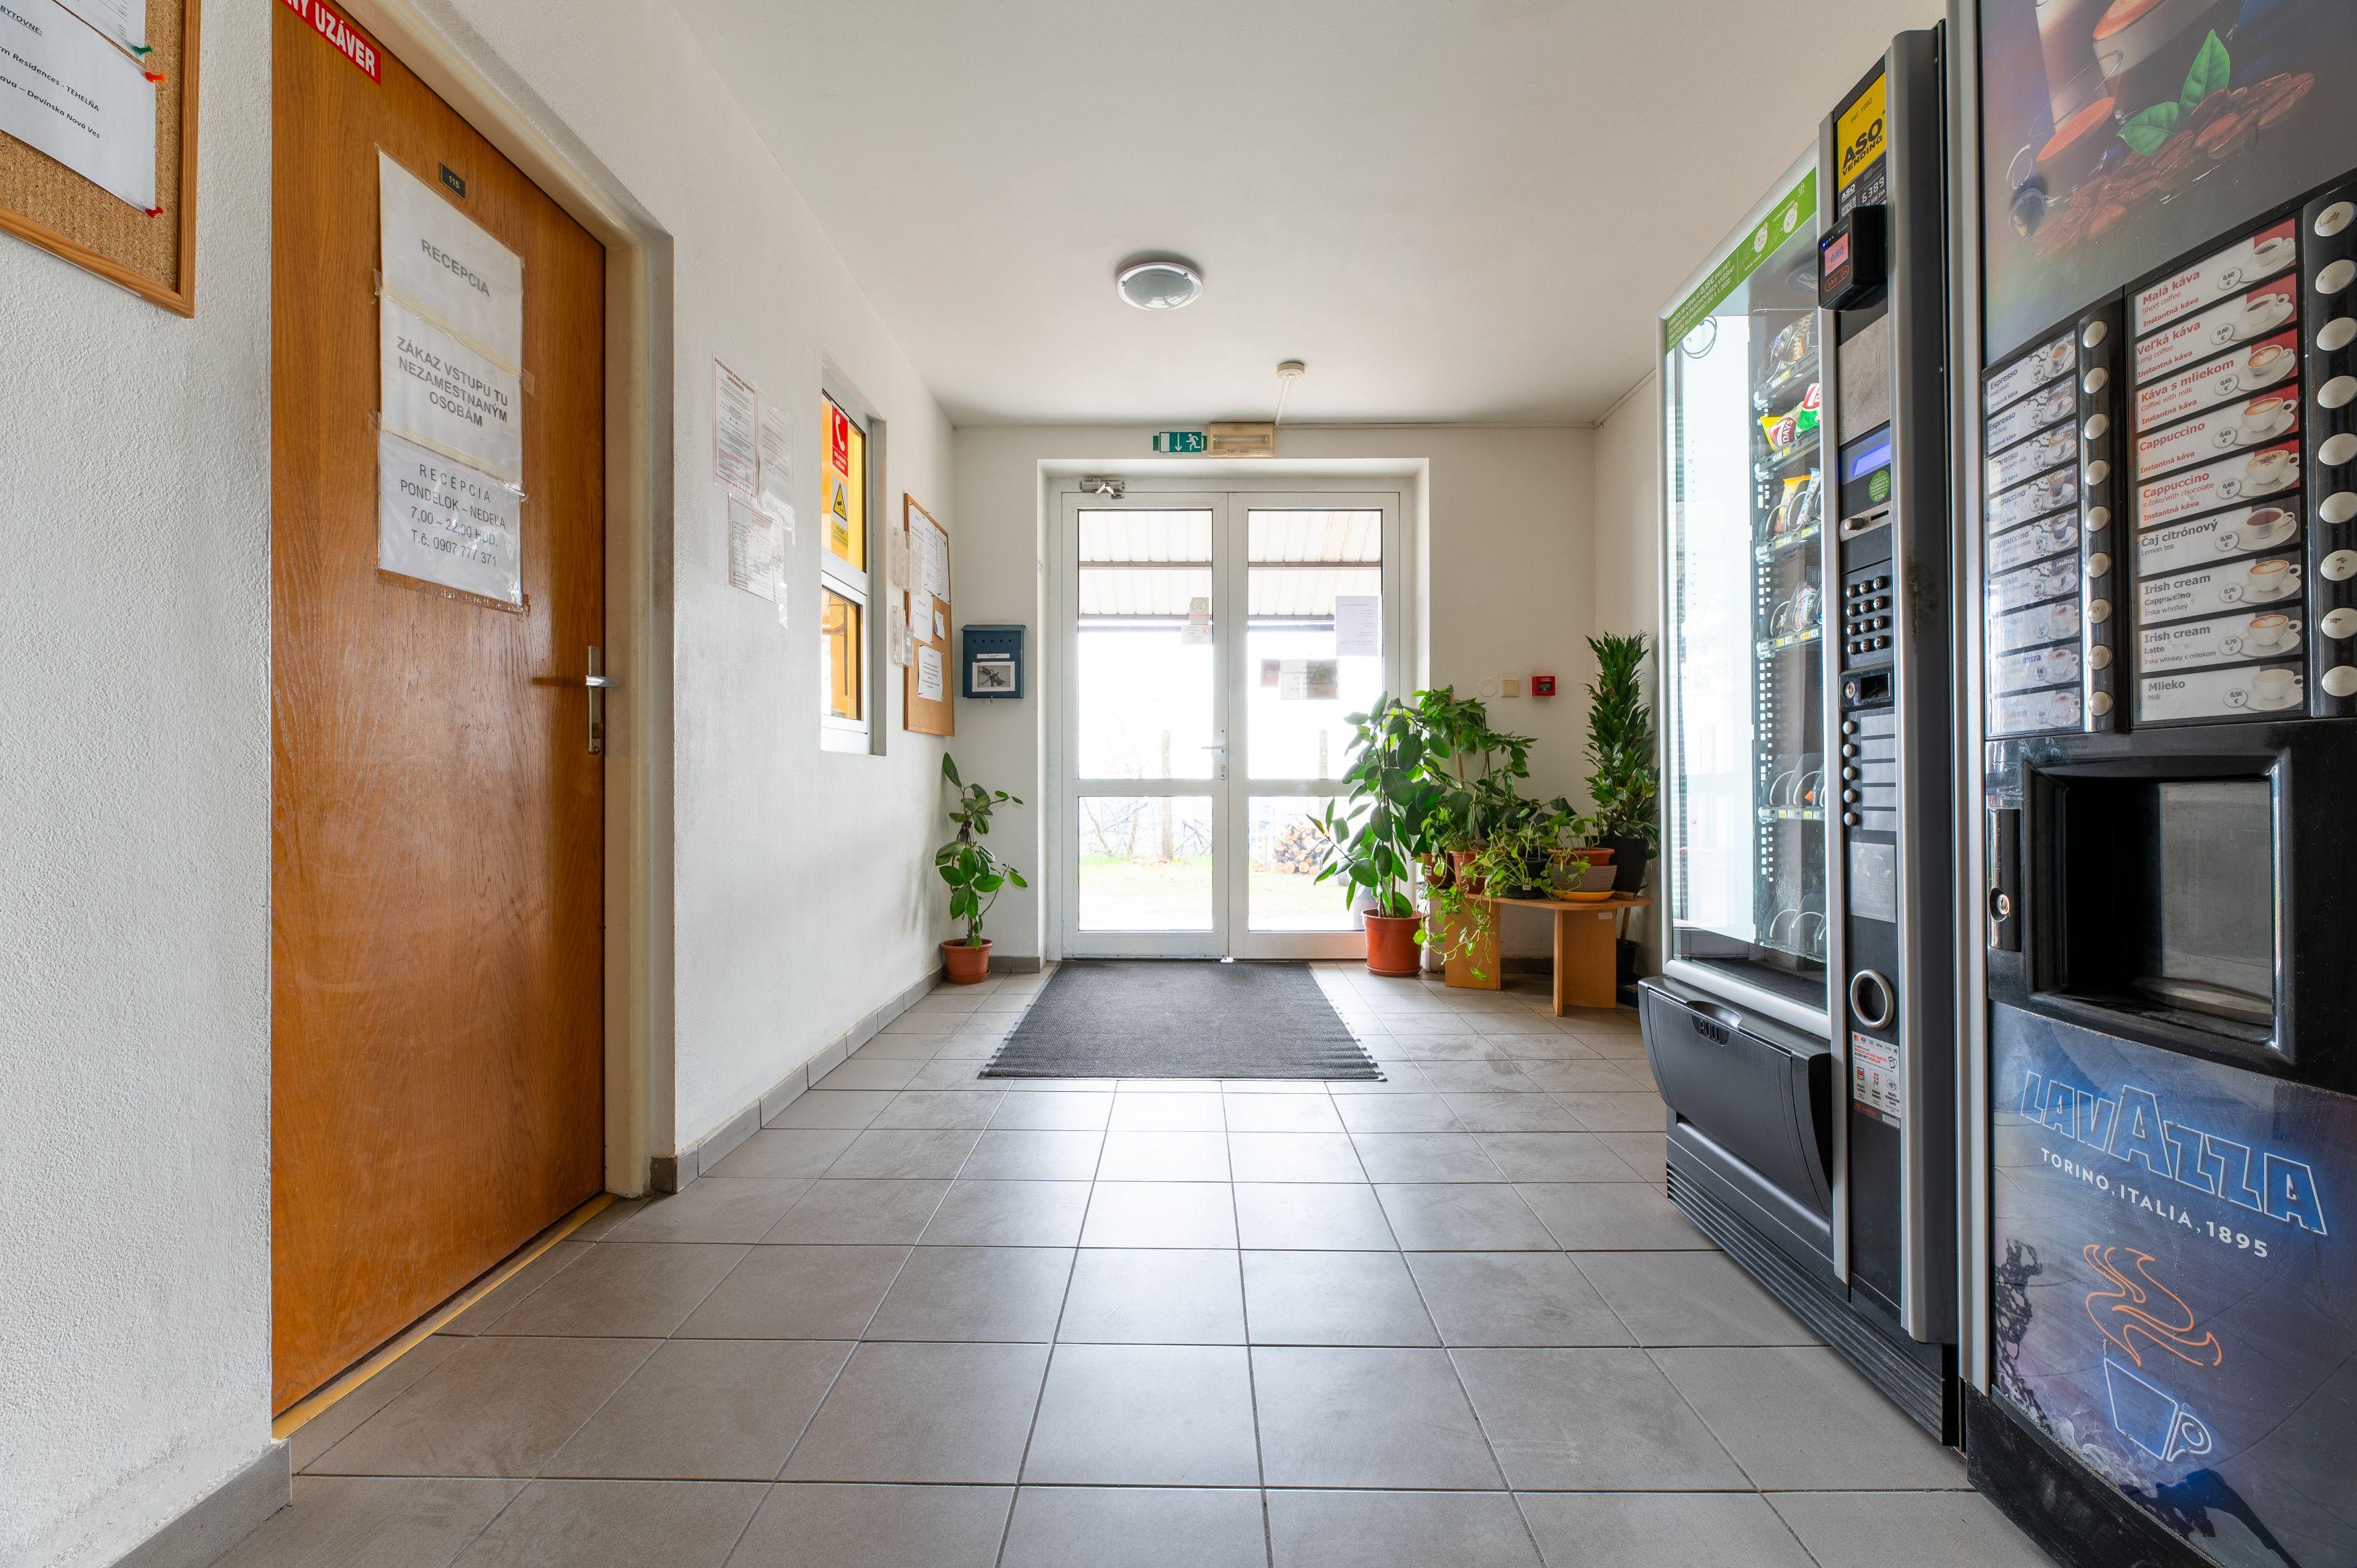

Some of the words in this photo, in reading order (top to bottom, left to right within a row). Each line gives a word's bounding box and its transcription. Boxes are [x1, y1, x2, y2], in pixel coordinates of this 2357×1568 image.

[0, 4, 43, 36] BYTOVNE:
[315, 2, 375, 77] UZÁVER
[12, 53, 60, 86] Residences
[66, 85, 99, 112] TEHELŇA
[27, 89, 65, 116] Devínska
[66, 113, 86, 130] Nová
[87, 126, 101, 139] Ves
[1860, 97, 1873, 113] 1992
[1842, 118, 1883, 170] ASO
[1842, 135, 1883, 176] VENDING
[448, 175, 460, 189] 115
[1841, 183, 1857, 200] ASO
[421, 239, 491, 298] RECEPCIA
[2223, 271, 2235, 281] 0,60
[2143, 285, 2169, 305] Malá
[2172, 271, 2201, 291] káva
[2142, 302, 2159, 314] Short
[2161, 291, 2181, 306] coffee
[2143, 306, 2178, 327] Instantná
[2181, 297, 2199, 310] káva
[2137, 335, 2170, 356] Veľká
[2173, 322, 2201, 340] káva
[2217, 327, 2228, 336] 0,60
[2137, 354, 2152, 365] Long
[2154, 345, 2173, 358] coffee
[2138, 359, 2173, 378] Instantná
[2174, 350, 2193, 362] káva
[397, 336, 441, 371] ZÁKAZ
[444, 362, 491, 398] VSTUPU
[494, 389, 508, 407] TU
[1990, 369, 2018, 390] Espresso
[2141, 385, 2168, 402] Káva
[2170, 382, 2178, 391] s
[2181, 359, 2234, 387] mliekom
[2220, 377, 2232, 386] 0,65
[399, 356, 508, 423] NEZAMESTNANÝM
[2008, 390, 2019, 399] káva
[2141, 399, 2162, 412] Coffee
[2162, 393, 2177, 404] with
[2178, 386, 2193, 397] milk
[429, 391, 483, 427] OSOBÁM
[1989, 412, 2016, 431] Espresso
[2141, 408, 2177, 425] Instantná
[2178, 400, 2197, 412] káva
[1783, 418, 1794, 444] DAYS
[2139, 422, 2206, 452] Cappuccino
[2140, 457, 2175, 474] Instantná
[2177, 451, 2196, 462] káva
[2143, 473, 2210, 499] Cappuccino
[401, 479, 460, 512] PONDELOK
[470, 505, 506, 529] NEDEĽA
[411, 506, 433, 525] 7,00
[2144, 505, 2179, 521] Instantná
[2181, 500, 2200, 510] káva
[2142, 534, 2159, 547] Čaj
[2162, 518, 2219, 542] citrónový
[2220, 534, 2233, 542] 0,50
[433, 537, 457, 554] 0907
[481, 552, 497, 567] 371
[2142, 547, 2162, 557] Lemon
[2144, 581, 2170, 595] Irish
[2173, 575, 2211, 589] cream
[2144, 592, 2191, 607] Cappuccino
[2162, 603, 2189, 613] whiskey
[2144, 631, 2170, 643] Irish
[2173, 626, 2211, 639] cream
[2159, 655, 2183, 664] whiskey
[2189, 650, 2216, 659] mliekom
[2148, 679, 2186, 692] Mlieko
[2019, 1070, 2328, 1236] LAVAZZA
[2205, 1220, 2268, 1258] 1895
